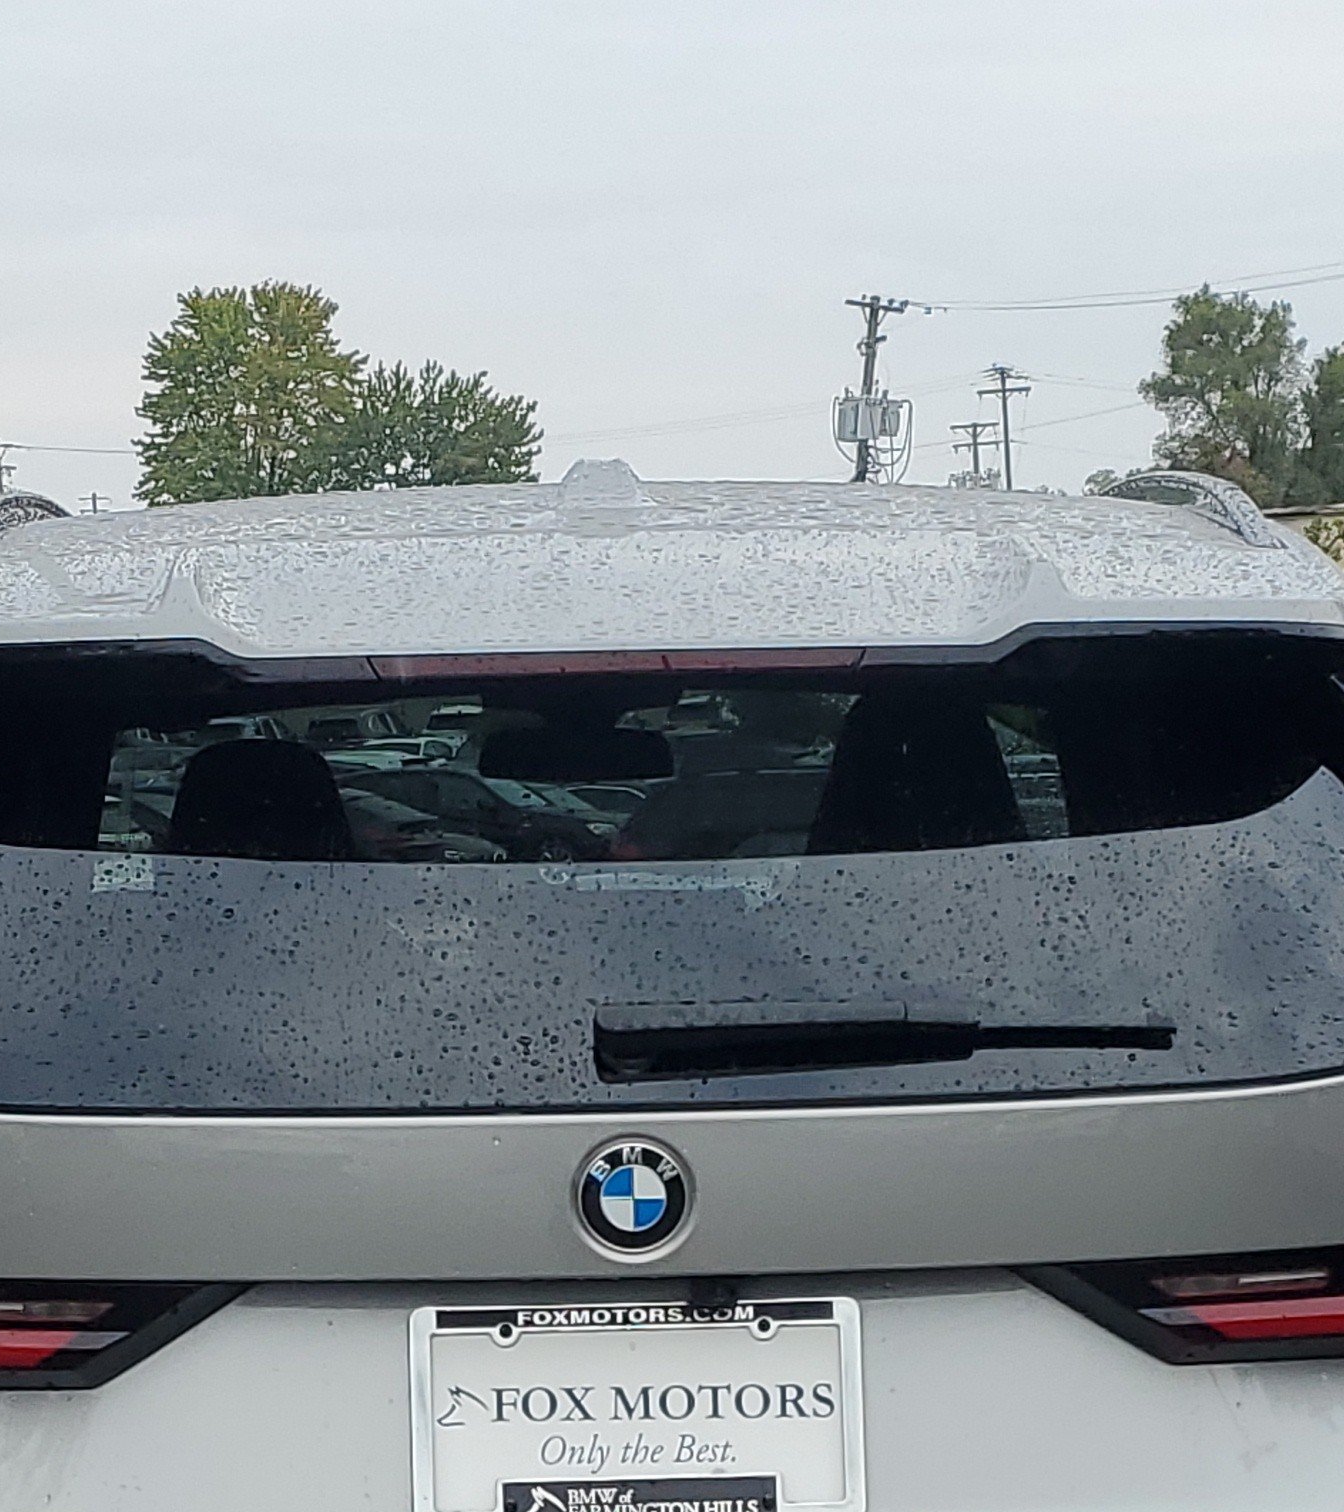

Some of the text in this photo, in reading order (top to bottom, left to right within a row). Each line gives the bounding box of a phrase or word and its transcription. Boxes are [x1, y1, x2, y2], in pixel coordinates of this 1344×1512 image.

[589, 1145, 678, 1183] BMW
[516, 1304, 755, 1327] FOXMOTORS.COM
[491, 1383, 836, 1422] FOX MOTORS
[540, 1433, 738, 1474] Only the Best.
[567, 1487, 635, 1504] BMW of
